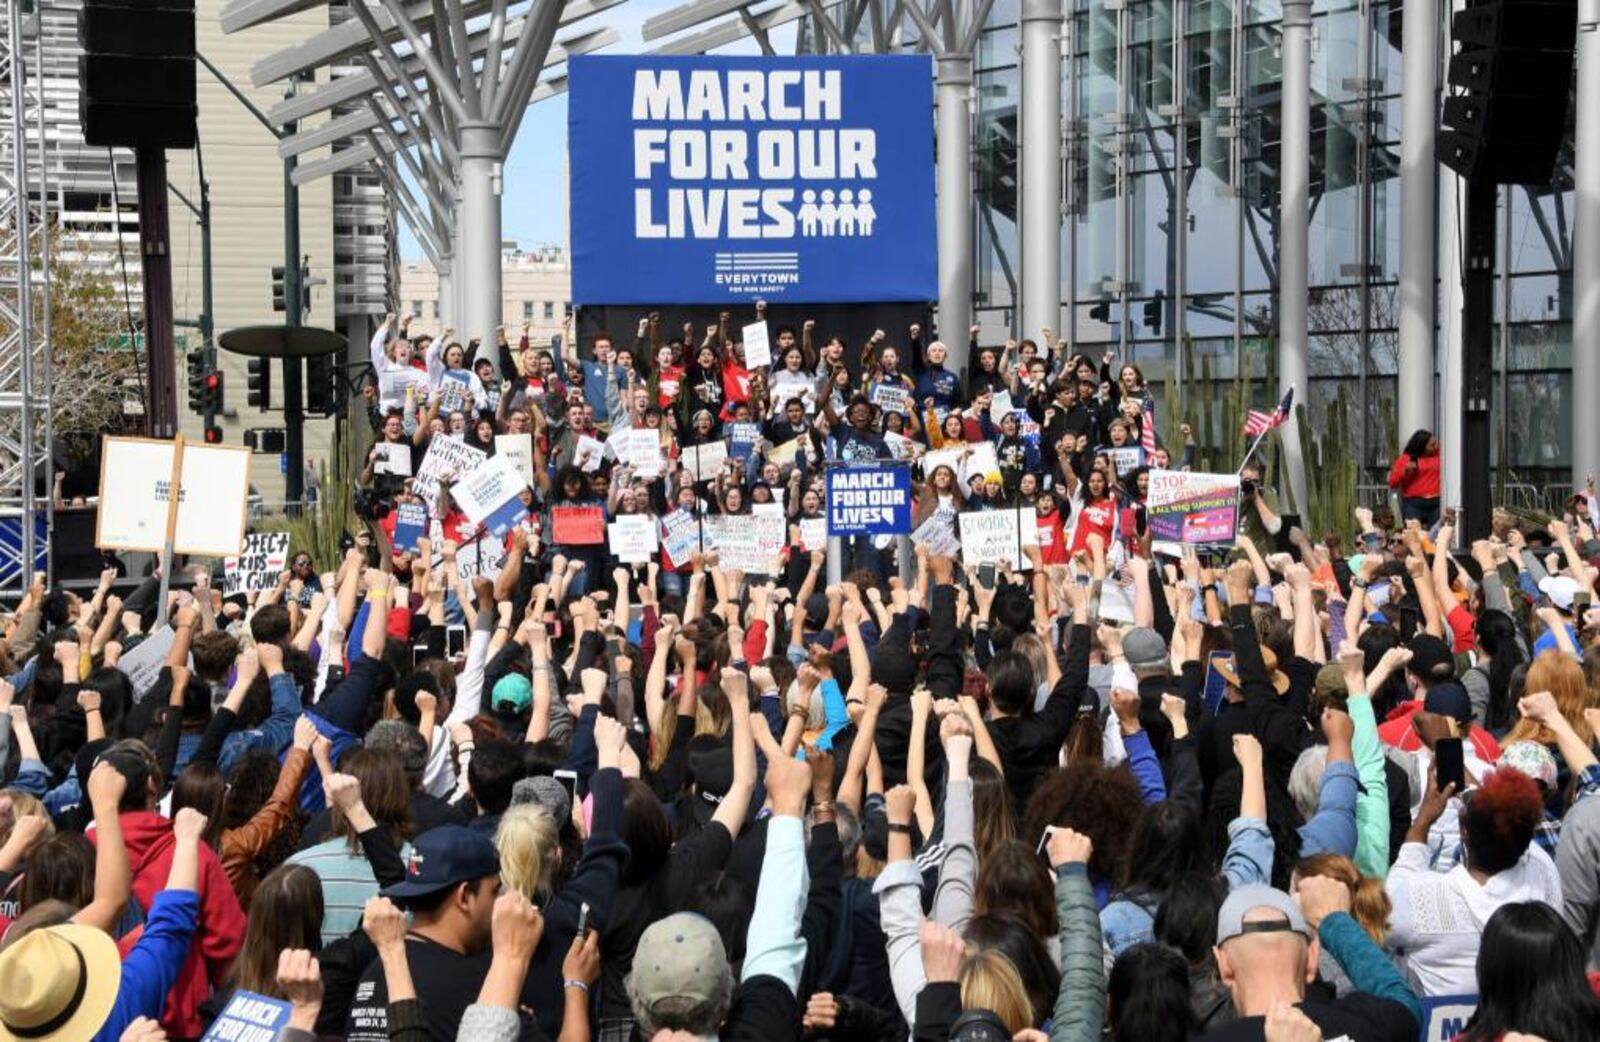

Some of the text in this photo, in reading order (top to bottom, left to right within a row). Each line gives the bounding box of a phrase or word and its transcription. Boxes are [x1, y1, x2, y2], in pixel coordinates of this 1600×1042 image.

[632, 69, 841, 121] MARCH
[634, 128, 878, 180] FOR OUR
[635, 188, 796, 239] LIVES
[715, 272, 799, 285] EVERYTOWN
[729, 286, 742, 294] FOR
[832, 472, 895, 489] MARCH
[1152, 475, 1187, 490] STOP
[832, 490, 905, 506] FOR OUR
[1156, 504, 1170, 513] ALL
[1171, 502, 1191, 512] WHO
[1192, 499, 1224, 509] SUPPORT
[832, 507, 881, 524] LIVES
[239, 553, 267, 571] KIDS
[246, 570, 283, 590] GUNS
[225, 995, 284, 1028] MARCH
[351, 1008, 367, 1018] MARCH
[366, 1007, 377, 1018] FOR
[210, 1016, 277, 1042] FOR OUR
[356, 1018, 371, 1027] MARCH
